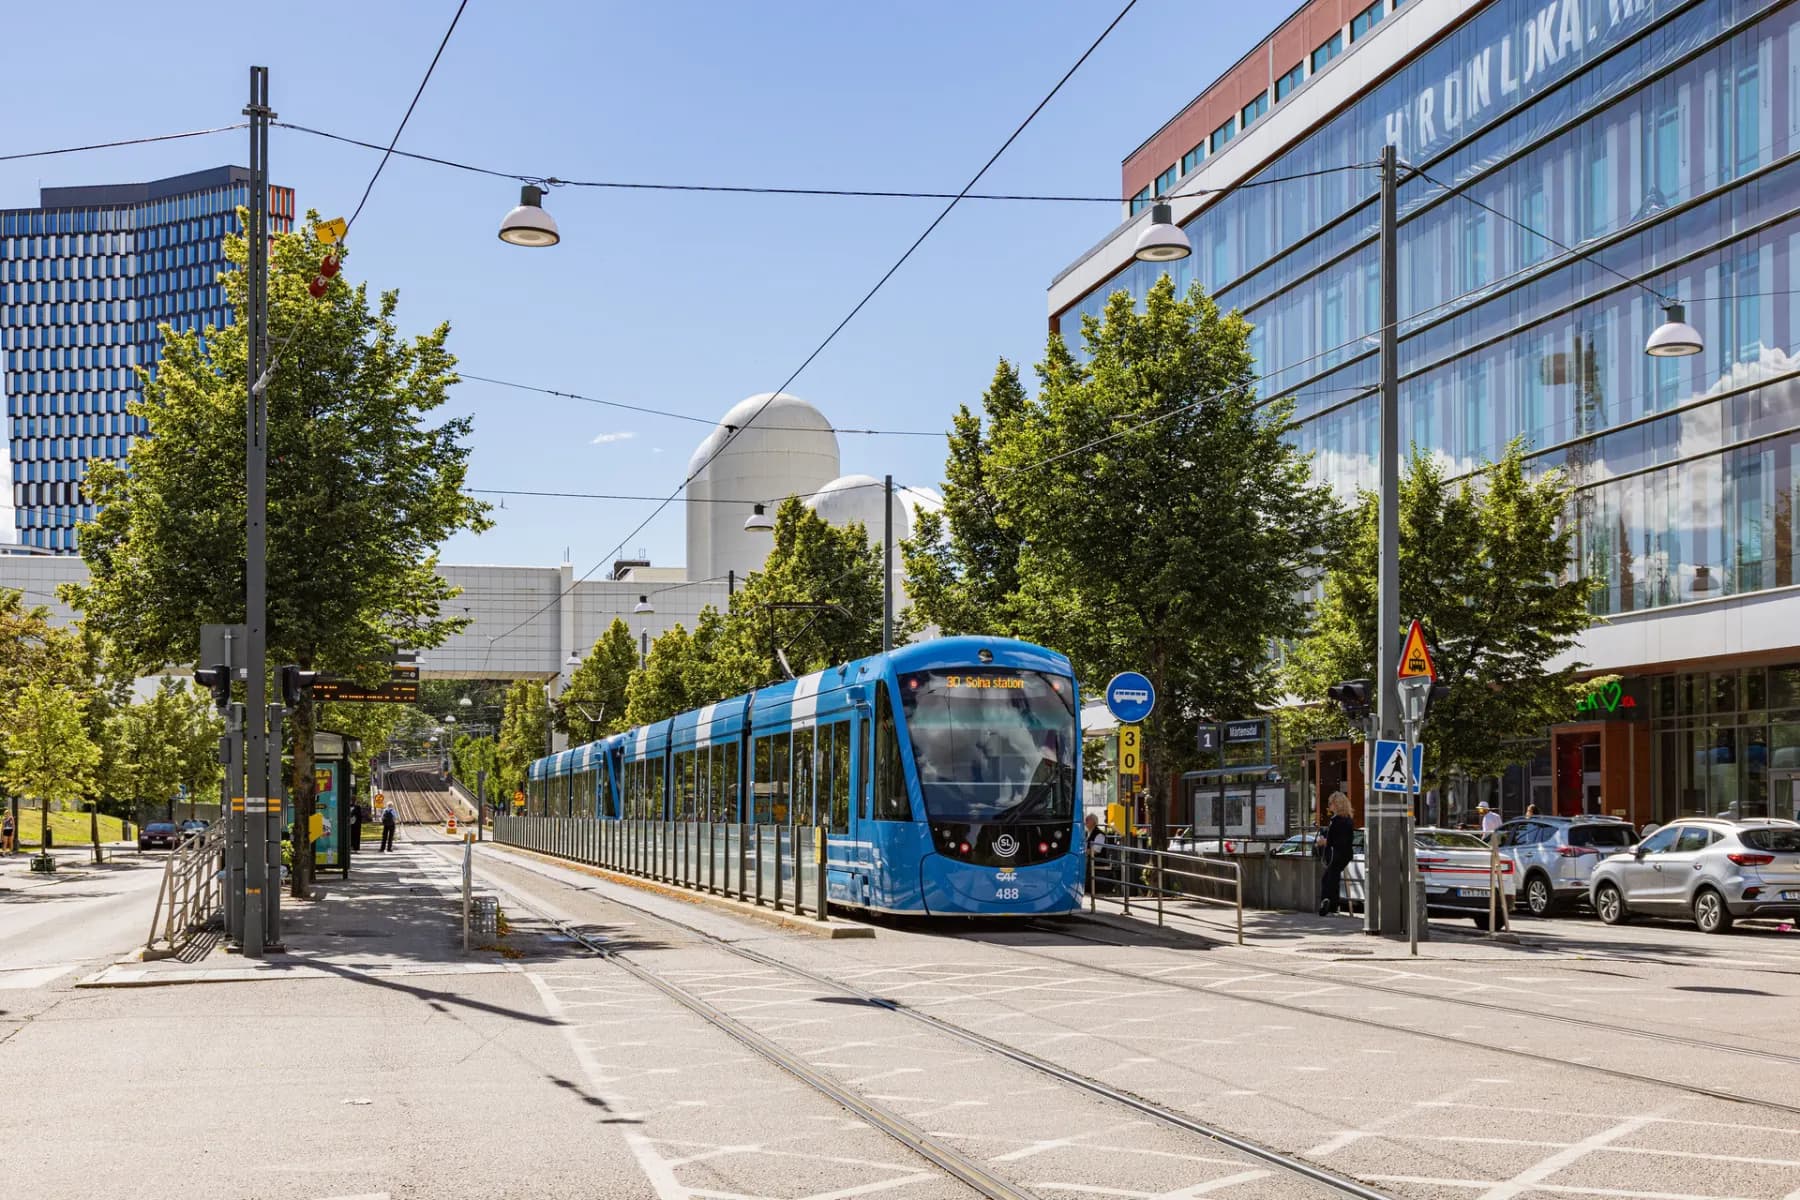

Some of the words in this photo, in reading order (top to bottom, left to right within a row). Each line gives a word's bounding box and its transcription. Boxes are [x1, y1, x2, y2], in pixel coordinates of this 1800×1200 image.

[965, 675, 991, 689] Solna
[992, 675, 1025, 689] station
[1203, 733, 1212, 748] 1
[1000, 838, 1011, 847] SL
[995, 888, 1020, 900] 488
